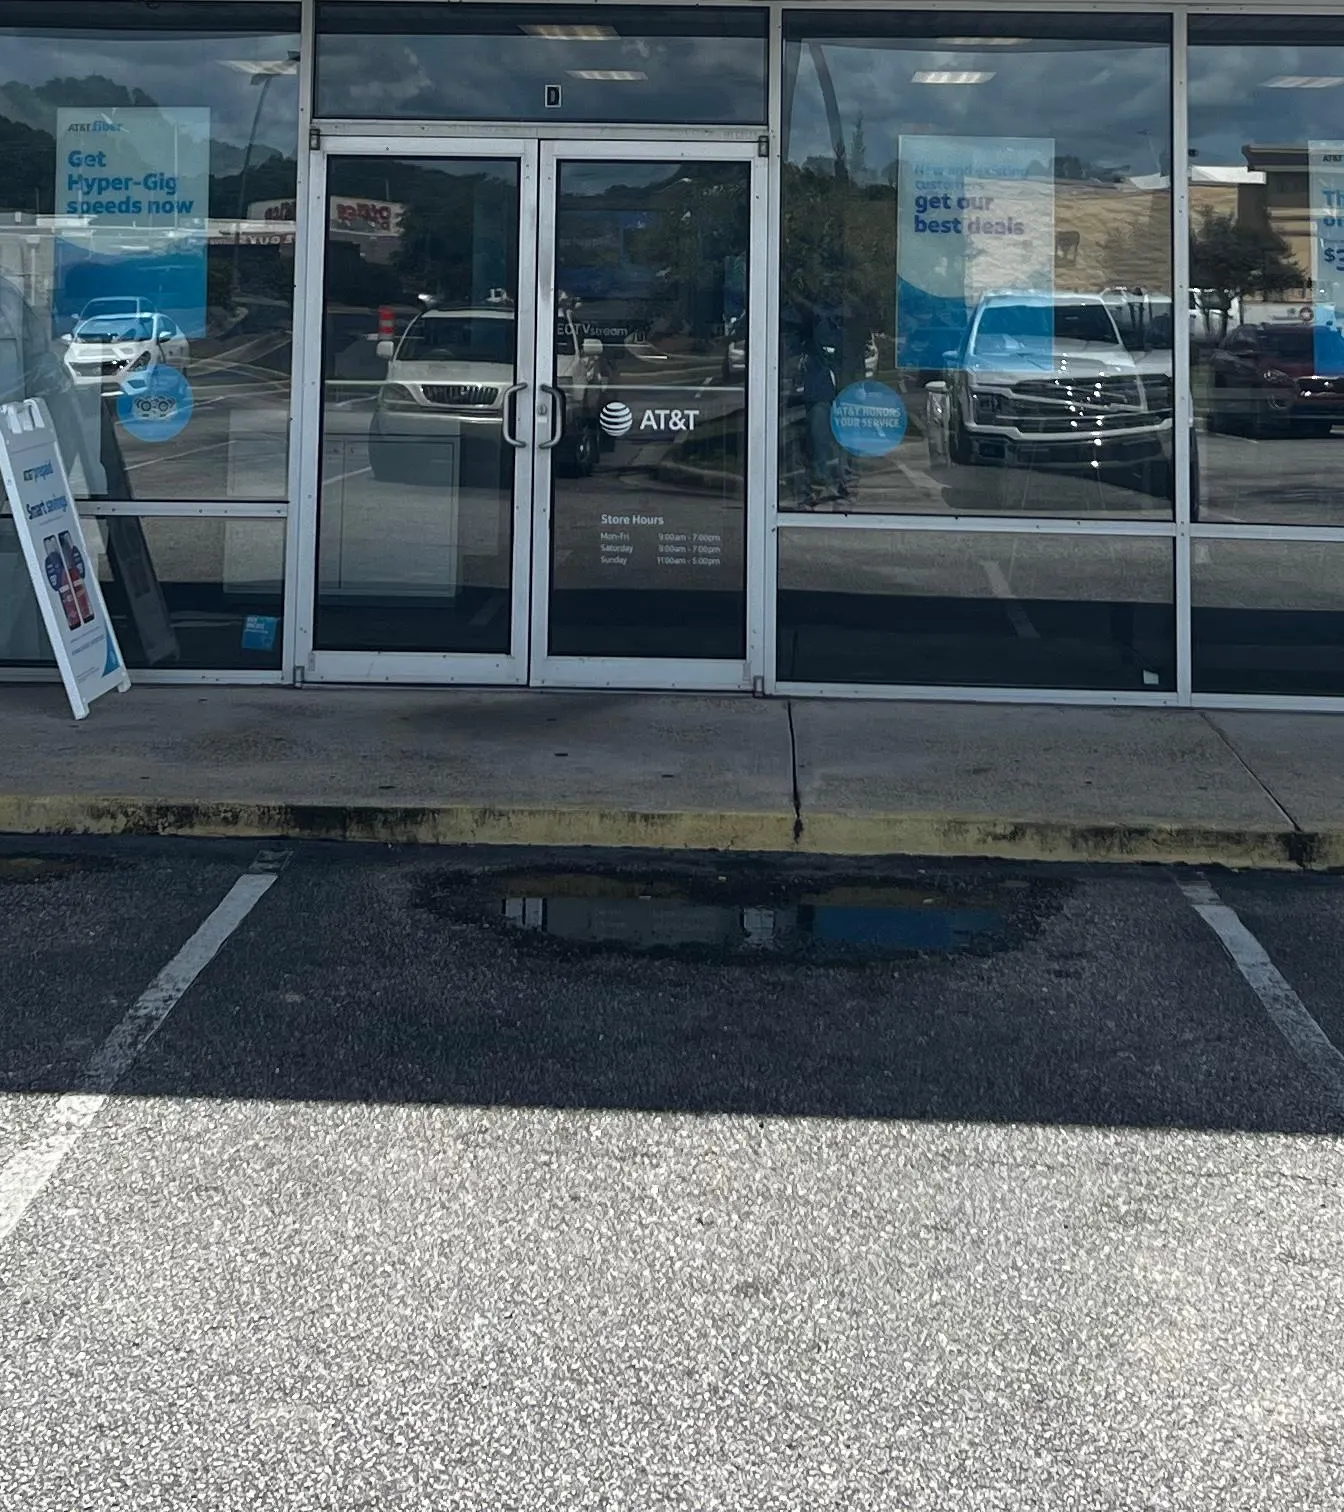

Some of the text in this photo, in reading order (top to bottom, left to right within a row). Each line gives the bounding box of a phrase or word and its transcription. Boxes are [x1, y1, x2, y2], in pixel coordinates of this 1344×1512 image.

[68, 150, 106, 167] Get
[68, 172, 178, 196] Hyper-Gig
[67, 196, 195, 217] speeds now
[915, 193, 994, 214] get our
[914, 215, 1025, 235] best deals
[557, 323, 590, 336] ECTV
[639, 409, 700, 431] AT&T
[836, 407, 861, 417] AT&T
[835, 417, 900, 428] YOUR SERVICE
[601, 514, 664, 525] Store Hours
[600, 556, 628, 566] Sunday
